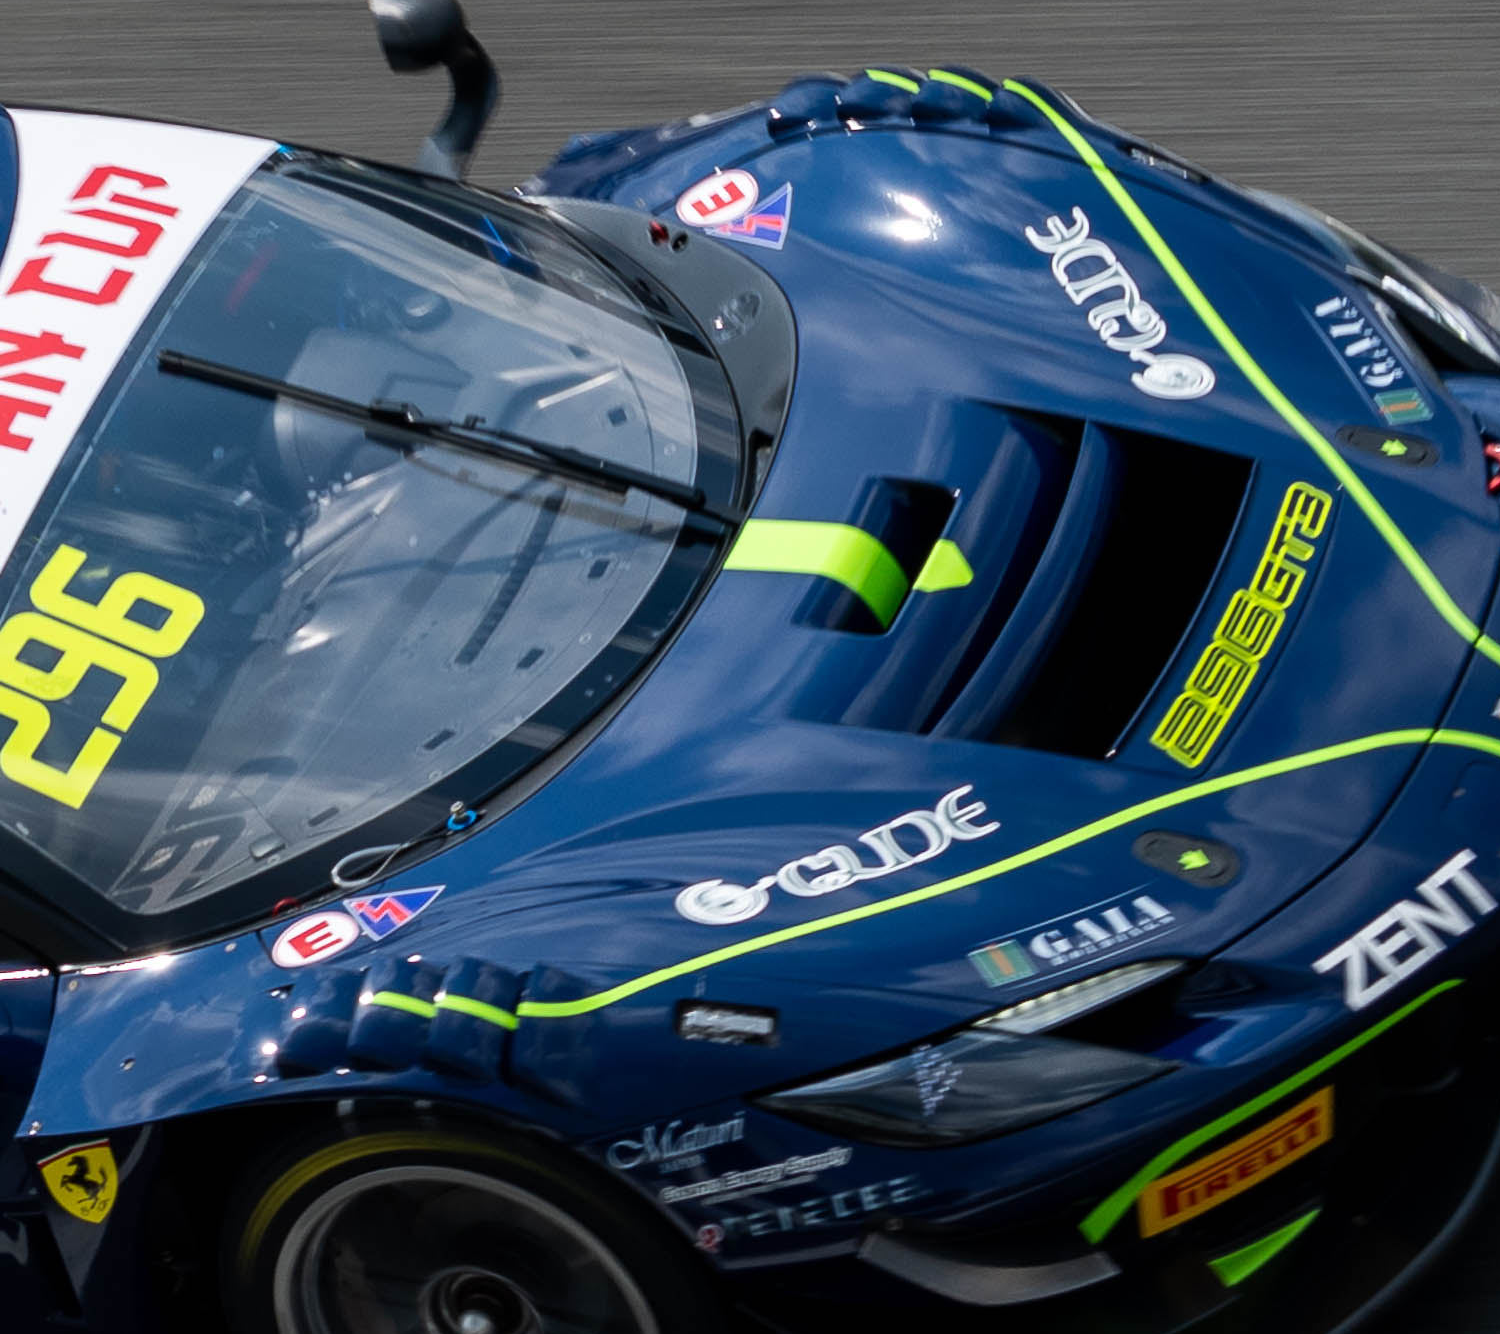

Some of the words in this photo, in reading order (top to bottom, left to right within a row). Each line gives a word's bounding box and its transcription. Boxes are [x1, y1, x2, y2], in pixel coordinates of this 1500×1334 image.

[5, 165, 180, 307] CUP
[1030, 895, 1172, 960] GAIA
[1311, 848, 1499, 1011] ZENT
[1161, 1103, 1321, 1221] PIRELLI
